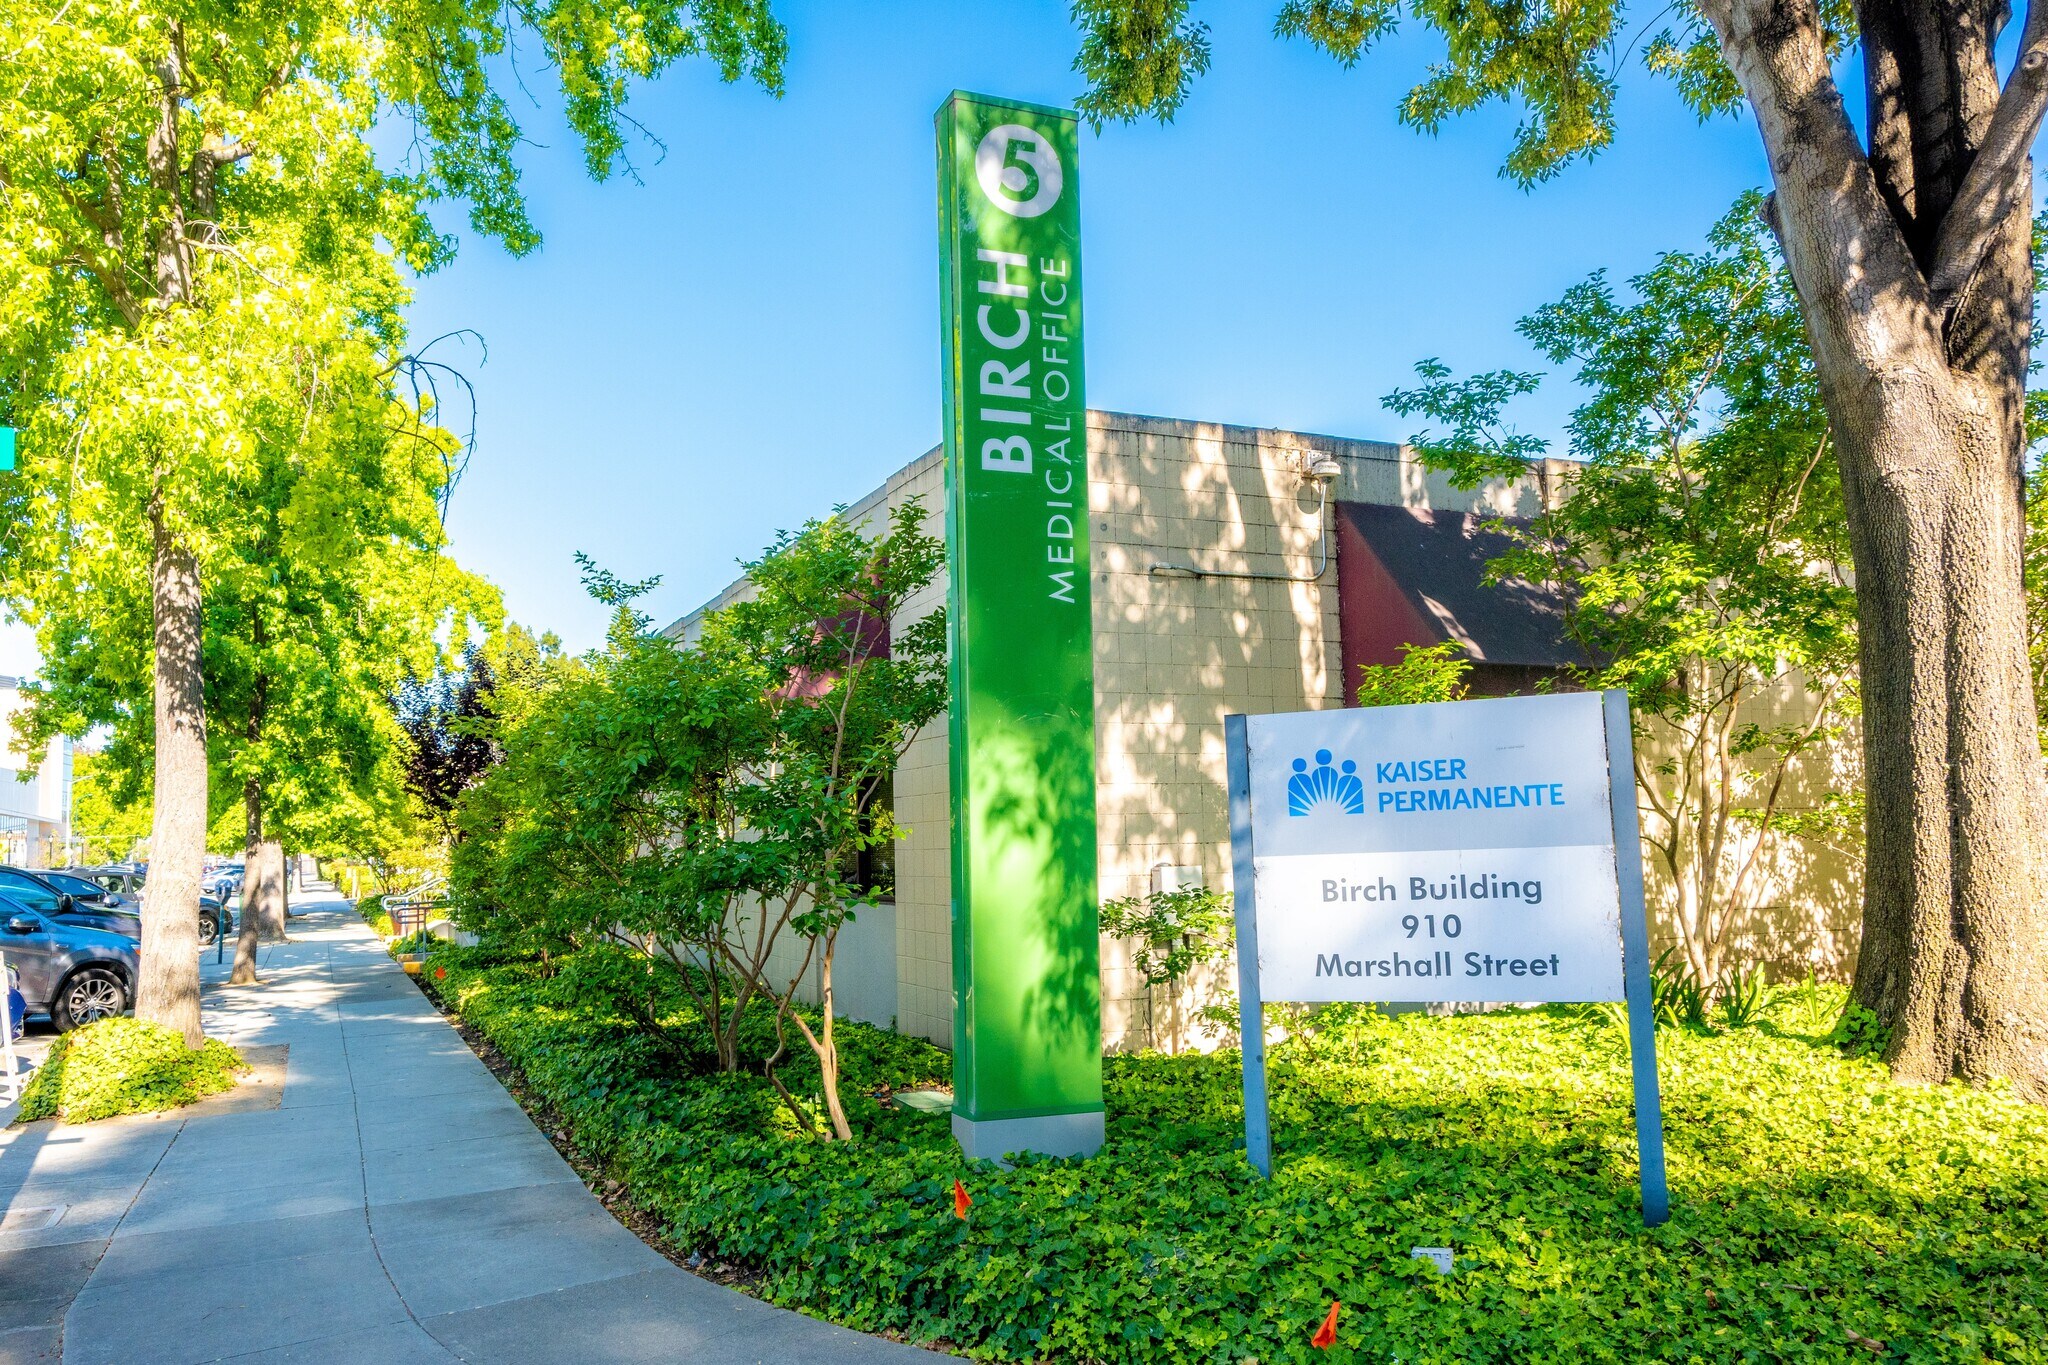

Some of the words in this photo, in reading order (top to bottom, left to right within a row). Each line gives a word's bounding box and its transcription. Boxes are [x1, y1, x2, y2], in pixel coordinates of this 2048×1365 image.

[999, 138, 1040, 202] 5
[1040, 257, 1071, 401] OFFICE
[977, 248, 1032, 474] BIRCH
[1046, 417, 1076, 604] MEDICAL
[1376, 758, 1467, 784] KAISER
[1378, 784, 1566, 813] PERMANENTE
[1322, 876, 1397, 903] Birch
[1409, 873, 1542, 905] Building
[1401, 914, 1462, 939] 910
[1315, 952, 1452, 978] Marshall
[1465, 952, 1560, 977] Street
